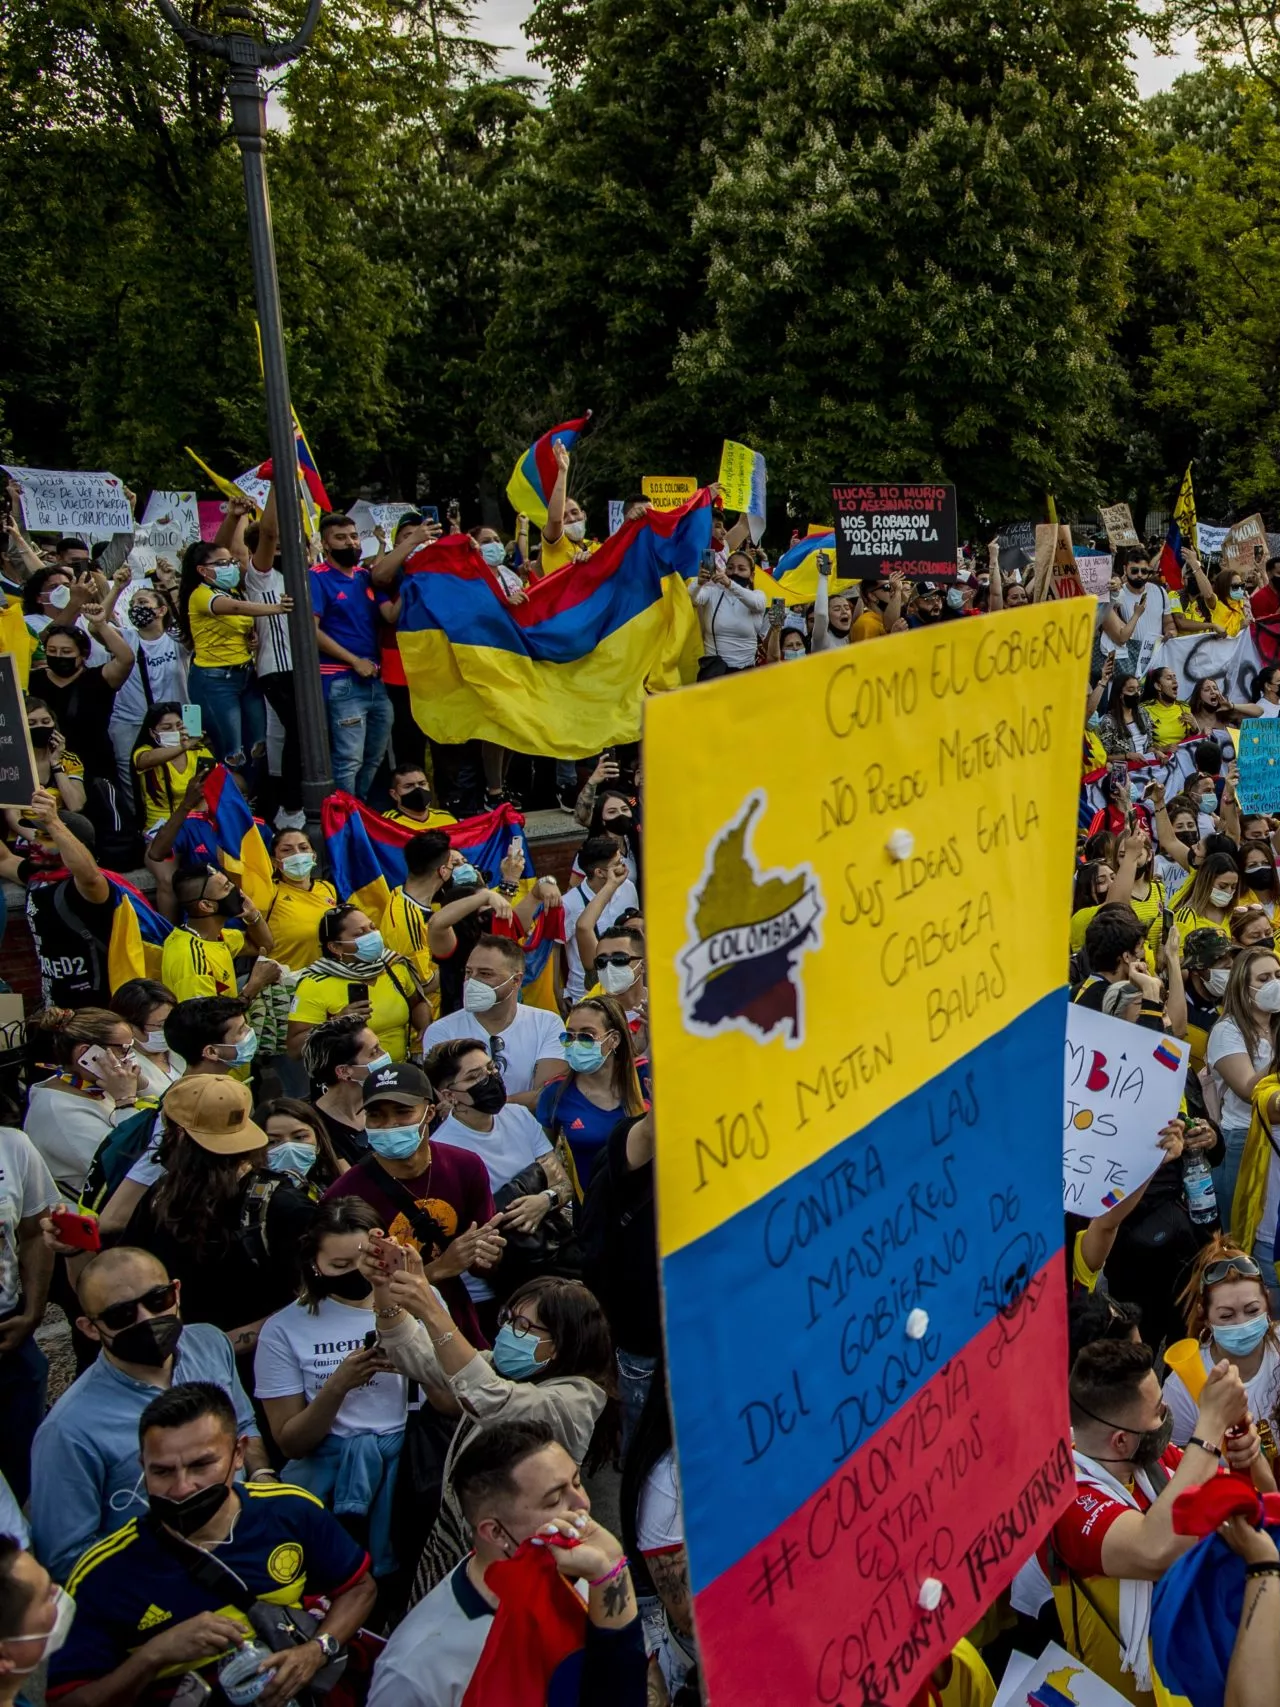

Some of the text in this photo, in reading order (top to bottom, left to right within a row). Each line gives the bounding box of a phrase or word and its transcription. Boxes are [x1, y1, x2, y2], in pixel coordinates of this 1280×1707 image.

[839, 500, 856, 511] LO
[841, 514, 929, 528] NOS ROBARON
[844, 529, 938, 543] TODO HASTA LA
[880, 487, 899, 499] NO
[825, 612, 1092, 739] COMO EL GOBIERNO
[817, 775, 858, 843] NO
[938, 704, 1053, 787] METERNOS
[1011, 793, 1039, 840] LA
[708, 912, 800, 966] COLOMBIA
[880, 890, 994, 987] CABEZA
[692, 942, 1007, 1194] NOS METEN BALAS
[762, 1071, 979, 1268] CONTRA LAS
[1103, 1159, 1129, 1187] TE
[804, 1153, 959, 1330] MASACRES
[839, 1228, 968, 1375] GOBIERNO
[989, 1183, 1020, 1233] DE
[830, 1332, 942, 1465] DUQUE
[747, 1359, 970, 1606] #COLOMBIA
[855, 1412, 984, 1582] ESTAMOS
[957, 1437, 1075, 1603] TRIBUTARIA
